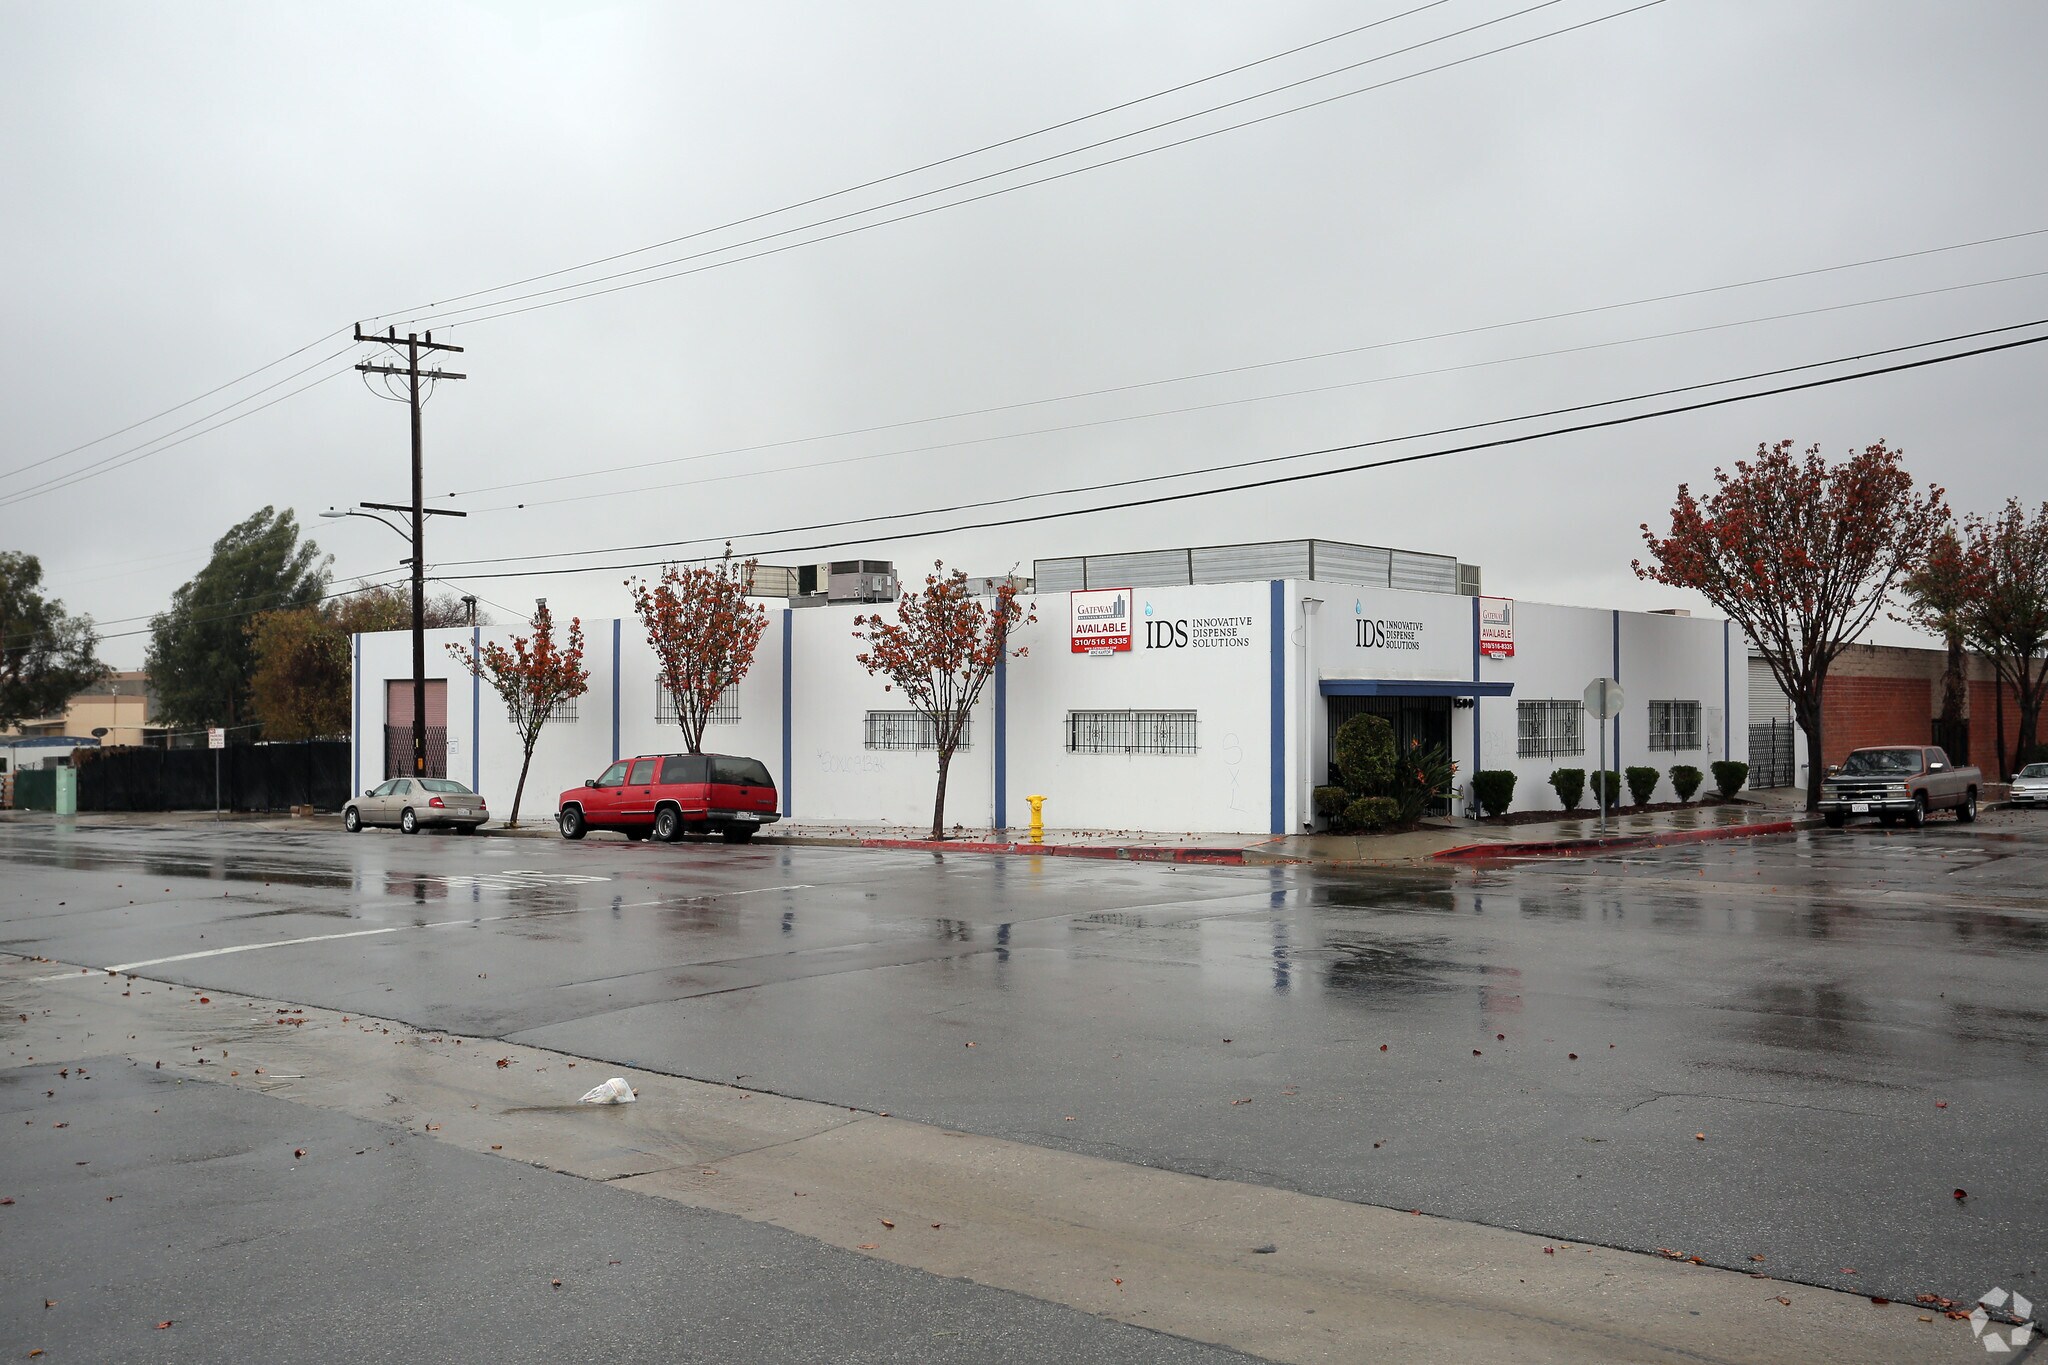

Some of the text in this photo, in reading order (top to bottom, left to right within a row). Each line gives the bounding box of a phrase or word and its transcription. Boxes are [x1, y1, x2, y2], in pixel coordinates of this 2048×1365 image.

[1078, 605, 1112, 614] GATEWAY
[1076, 622, 1127, 634] AVAILABLE
[1192, 617, 1252, 628] INNOVATIVE
[1386, 620, 1423, 631] INNOVATIVE
[1145, 619, 1188, 649] IDS
[1192, 628, 1237, 638] DISPENSE
[1356, 619, 1385, 648] IDS
[1386, 630, 1415, 640] DISPENSE
[1482, 628, 1511, 639] AVAILABLE
[1192, 638, 1249, 648] SOLUTIONS
[1386, 640, 1420, 650] SOLUTIONS
